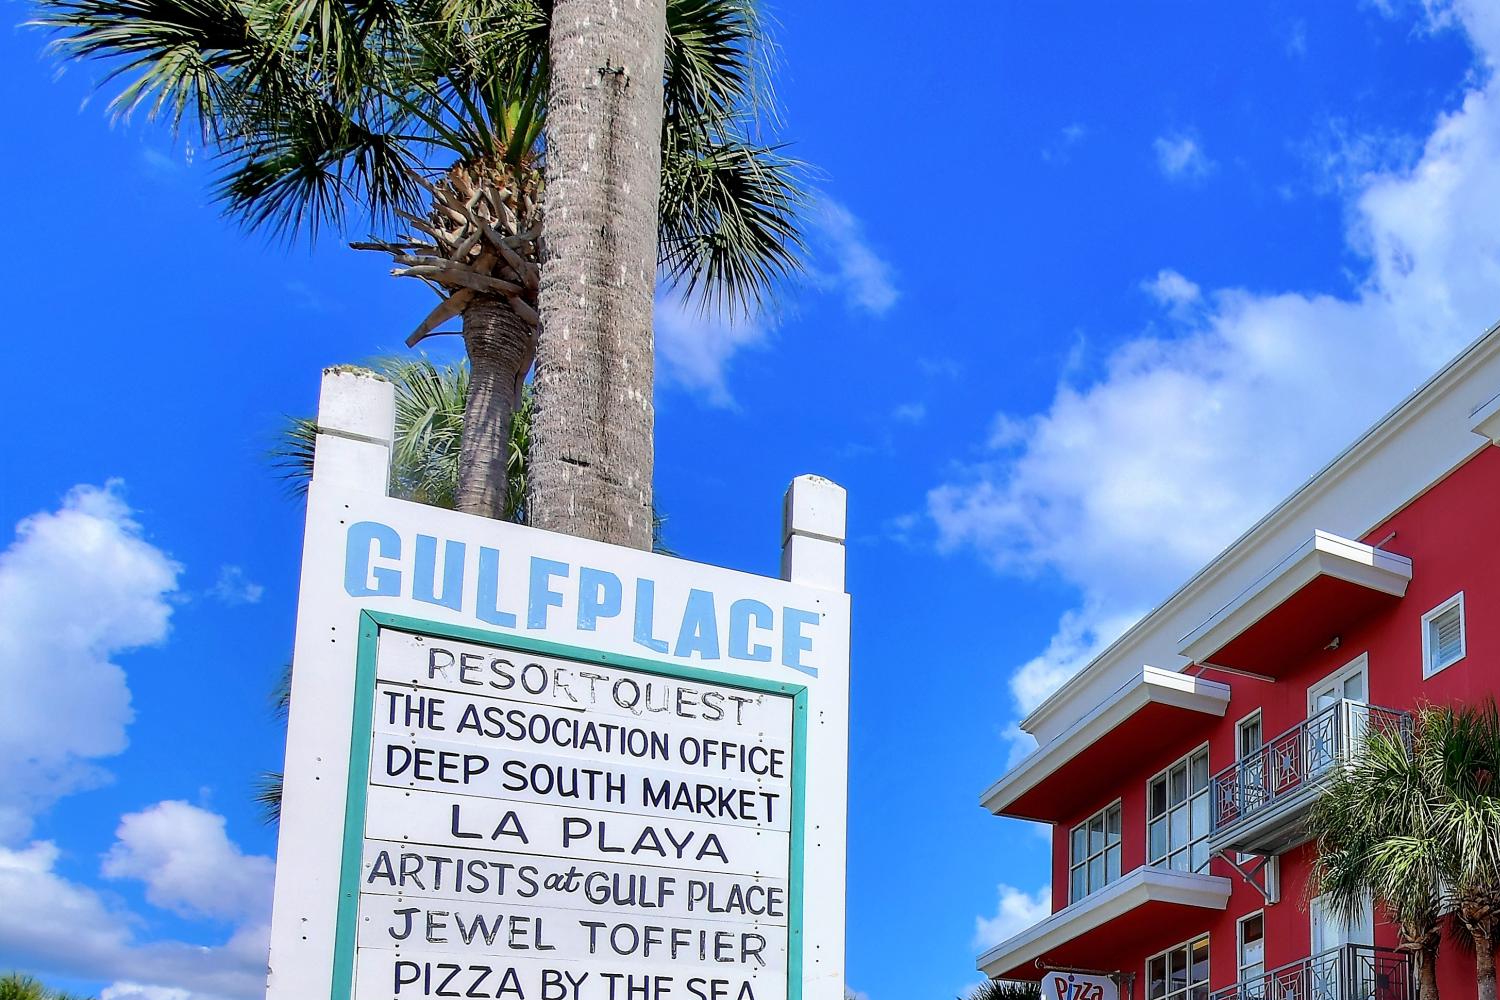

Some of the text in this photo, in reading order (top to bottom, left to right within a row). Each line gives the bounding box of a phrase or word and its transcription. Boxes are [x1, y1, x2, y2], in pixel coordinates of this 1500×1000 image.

[383, 690, 785, 779] THE ASSOCIATION OFFICE
[386, 744, 780, 823] DEEP SOUTH MARKET
[451, 804, 729, 864] LA PLAYA
[367, 850, 784, 917] ARTISTS at GULF PLACE
[388, 907, 767, 967] JEWEL TOFFIER
[394, 960, 525, 1000] PIZZA
